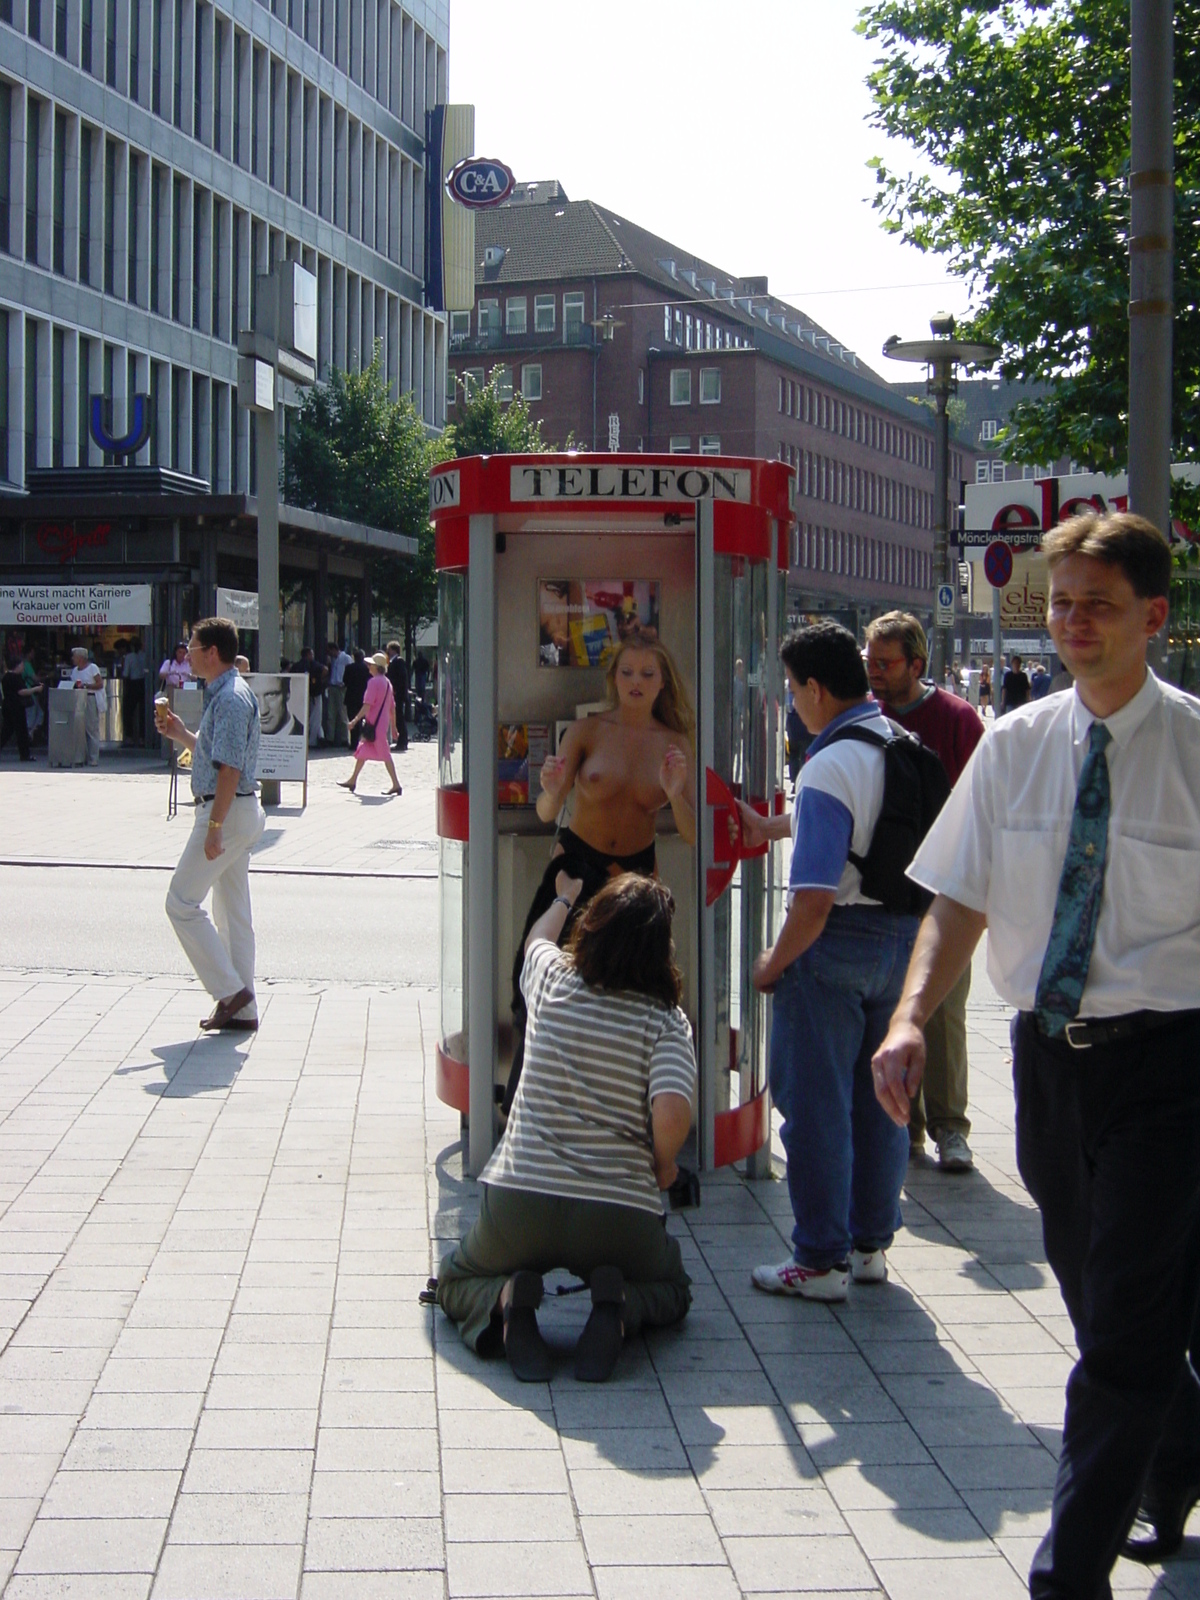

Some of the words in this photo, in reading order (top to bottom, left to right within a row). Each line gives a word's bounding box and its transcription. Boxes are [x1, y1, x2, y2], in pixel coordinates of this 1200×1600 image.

[460, 170, 502, 193] C&A
[90, 393, 151, 455] U
[522, 467, 739, 499] TELEFON
[957, 532, 1046, 546] Mönckebergstraß
[18, 588, 49, 598] Wurst
[52, 588, 86, 598] macht
[89, 587, 131, 598] Karriere
[12, 600, 60, 610] Krakauer
[63, 602, 86, 610] vom
[89, 600, 110, 610] Grill
[16, 613, 62, 623] Gourmet
[65, 613, 107, 623] Qualität
